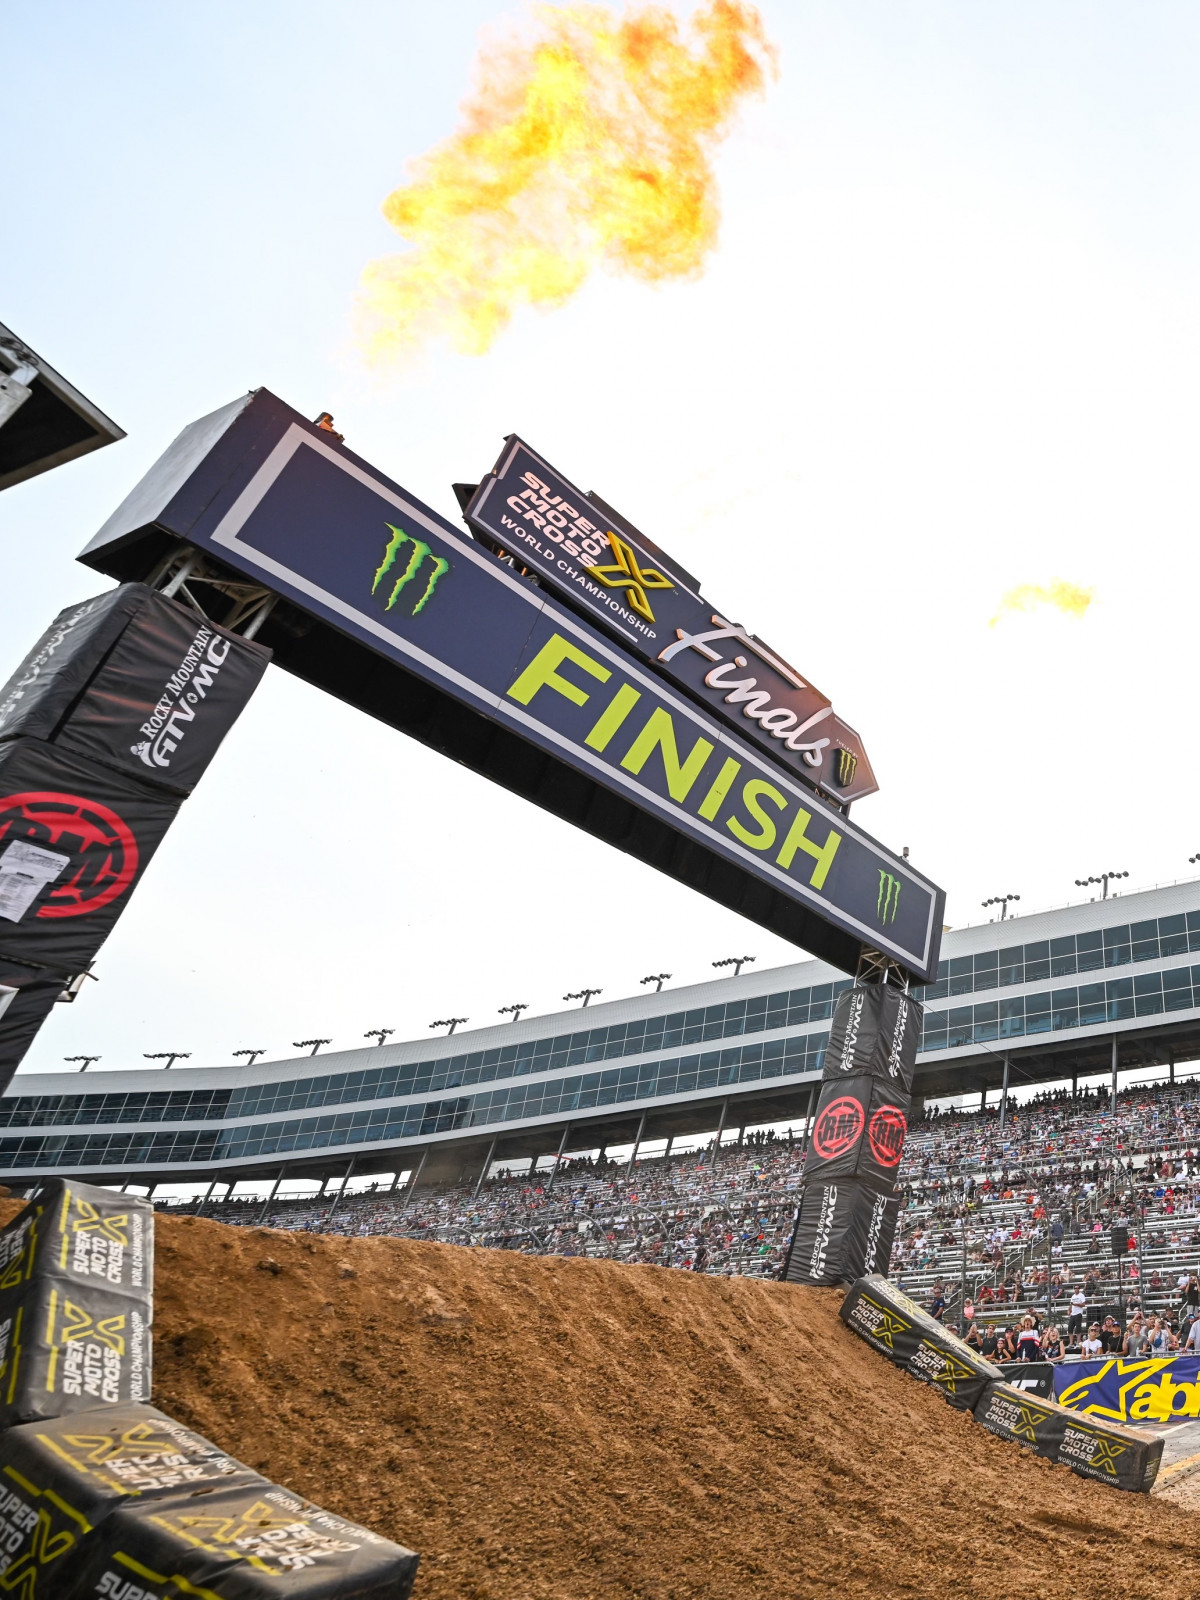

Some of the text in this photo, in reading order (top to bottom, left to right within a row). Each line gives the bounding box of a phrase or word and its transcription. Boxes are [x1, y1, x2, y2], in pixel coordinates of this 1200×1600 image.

[506, 495, 598, 567] CROSS
[519, 472, 611, 550] SUPER
[520, 489, 601, 556] MOTO
[501, 515, 657, 639] WORLD CHAMPIONSHIP
[139, 624, 213, 738] ROCKY MOUNTAIN
[656, 614, 833, 768] Finals
[506, 633, 842, 890] FINISH
[73, 1230, 92, 1275] SUPER
[90, 1236, 107, 1278] MOTO
[107, 1239, 123, 1284] CROSS
[851, 1310, 878, 1331] CROSS
[856, 1305, 880, 1325] MOTO
[857, 1298, 884, 1320] SUPER
[63, 1339, 85, 1396] SUPER
[83, 1343, 102, 1397] MOTO
[101, 1346, 121, 1403] CROSS
[910, 1355, 939, 1378] CROSS
[915, 1350, 941, 1371] MOTO
[917, 1343, 946, 1367] SUPER
[985, 1411, 1017, 1430] CROSS
[990, 1396, 1022, 1415] SUPER
[990, 1404, 1017, 1422] MOTO
[1059, 1443, 1094, 1462] CROSS
[1063, 1437, 1094, 1454] MOTO
[1064, 1428, 1099, 1447] SUPER
[1057, 1455, 1120, 1485] WORLD CHAMPIONSHIP
[0, 1483, 39, 1534] UPER
